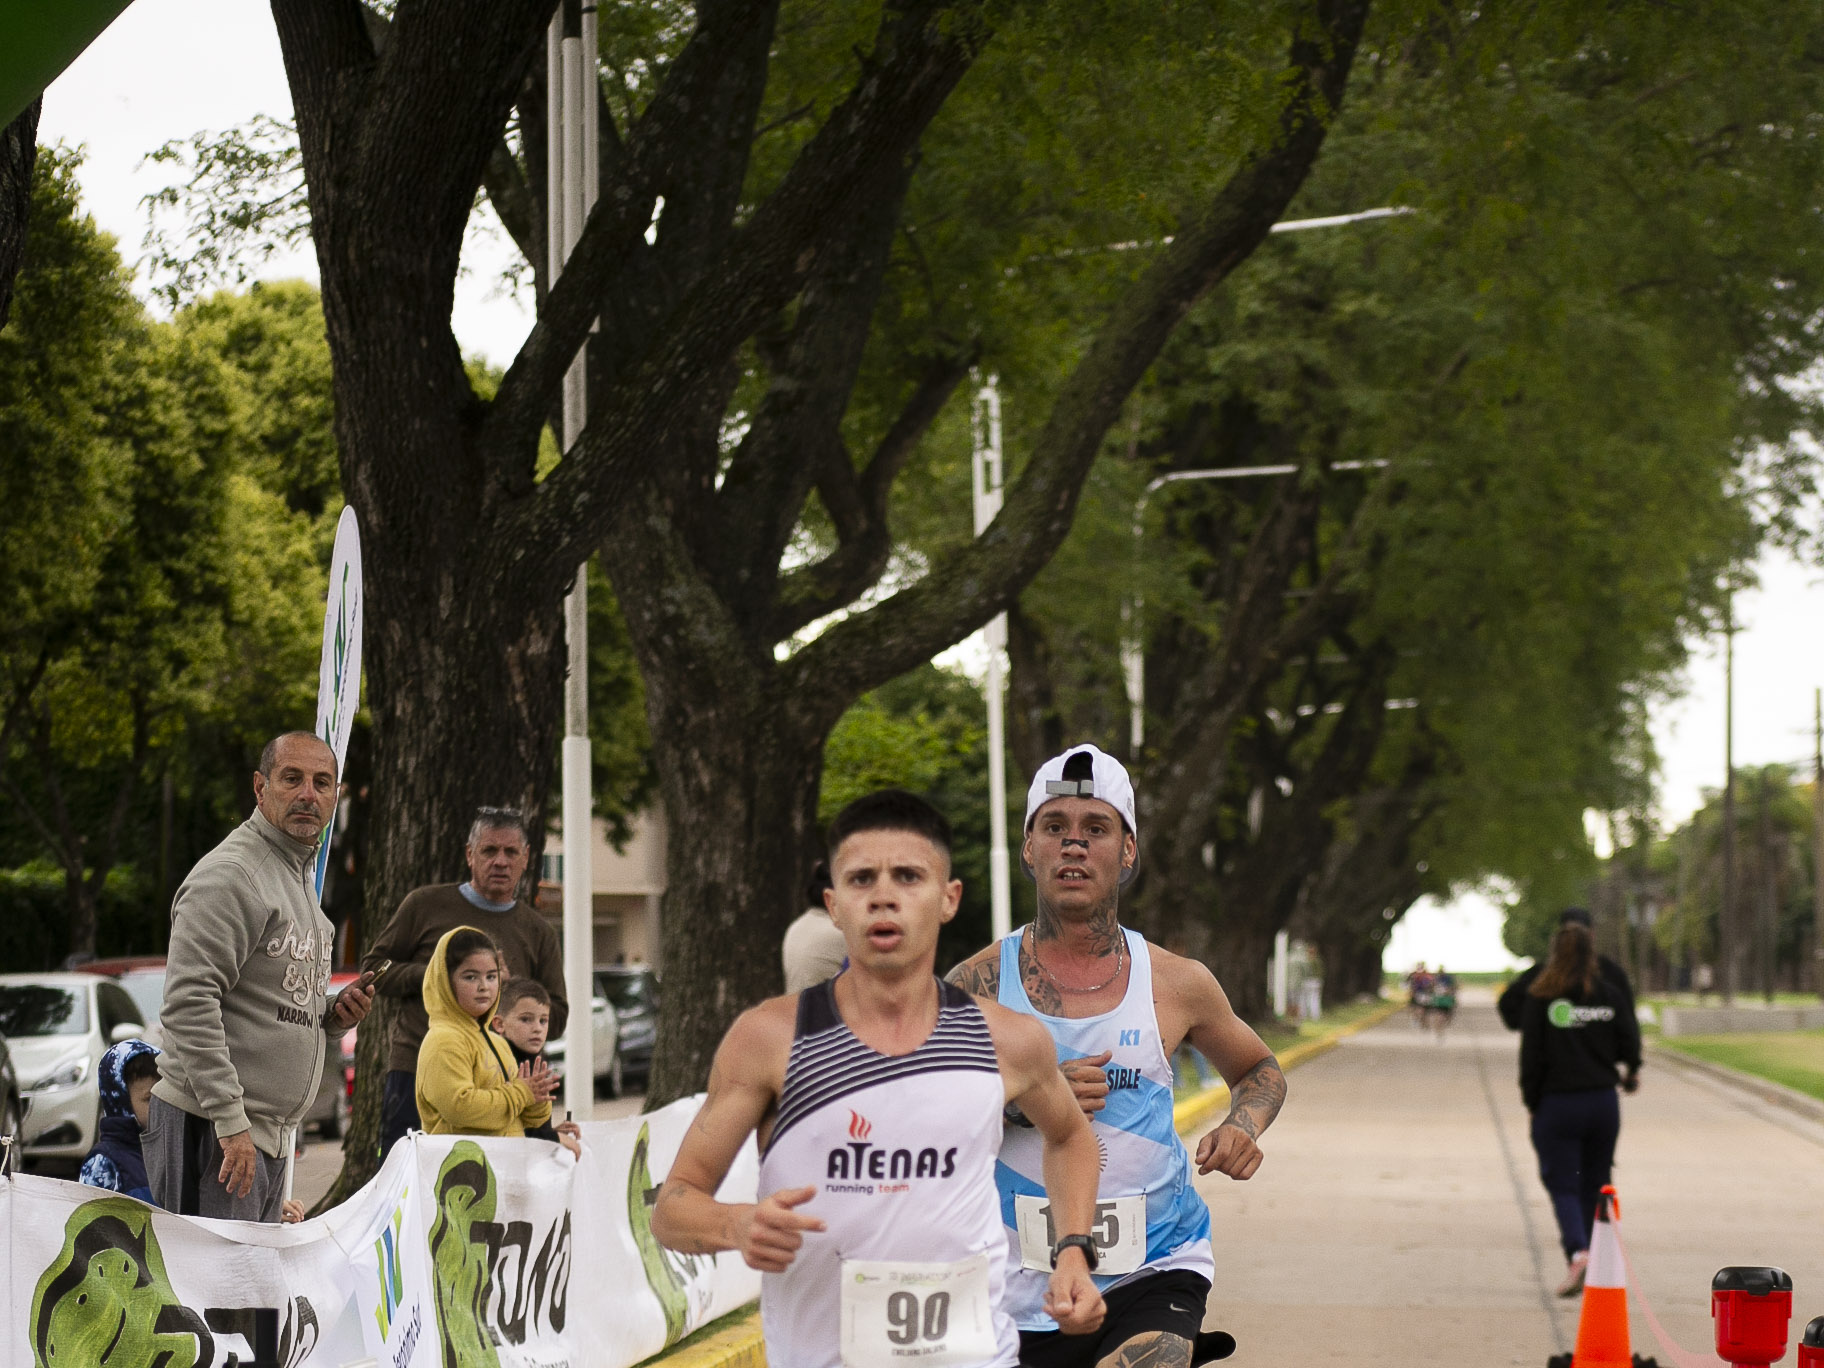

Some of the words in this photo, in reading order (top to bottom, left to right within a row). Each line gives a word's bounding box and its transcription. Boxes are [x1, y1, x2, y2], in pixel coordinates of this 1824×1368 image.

[276, 1006, 314, 1029] NARROW
[1119, 1029, 1141, 1047] K1
[1107, 1068, 1142, 1091] SIBLE
[827, 1142, 958, 1180] ATENAS
[825, 1183, 874, 1195] running
[878, 1184, 910, 1193] team
[1038, 1202, 1120, 1249] 15
[887, 1291, 951, 1345] 90
